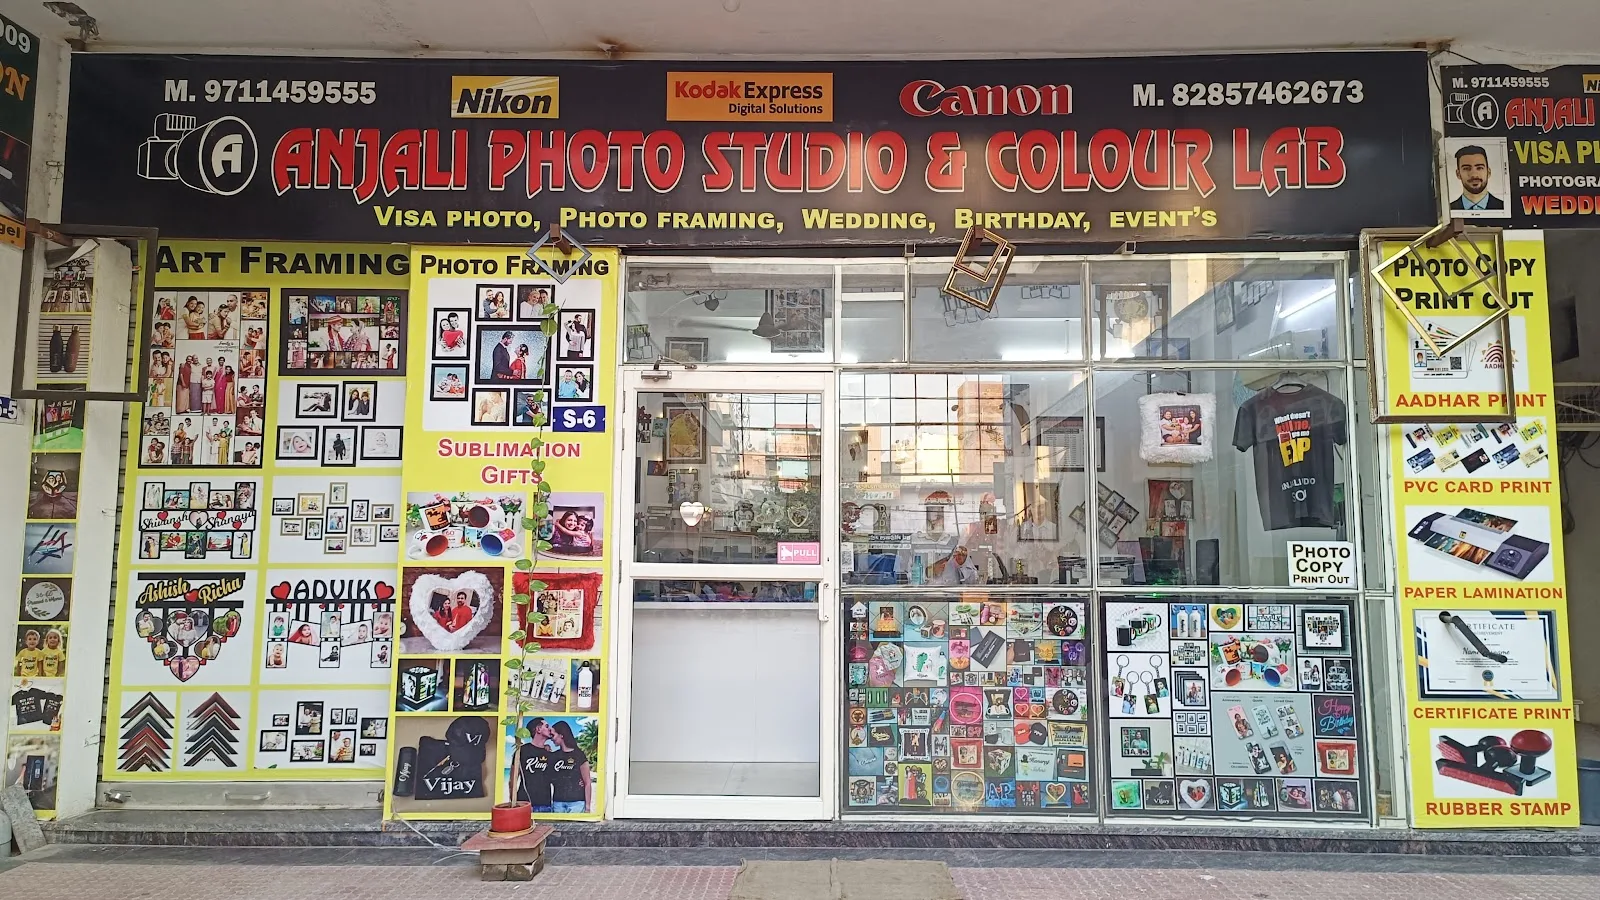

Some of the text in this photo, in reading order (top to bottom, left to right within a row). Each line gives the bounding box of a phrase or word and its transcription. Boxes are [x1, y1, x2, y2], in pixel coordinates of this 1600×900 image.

[0, 20, 31, 54] 09
[0, 64, 30, 101] N
[164, 78, 377, 105] M. 9711459555
[674, 80, 823, 103] Kodak Express
[1452, 76, 1550, 89] M. 9711459555
[456, 87, 553, 115] Nikon
[899, 79, 1073, 117] Canon
[1132, 80, 1364, 107] M. 82857462673
[728, 102, 823, 115] Digital Solutions
[1504, 97, 1596, 133] ANJALI
[211, 133, 243, 178] A
[1514, 140, 1572, 165] VISA
[271, 125, 1347, 205] ANJALI PHOTO STUDIO & COLOUR LAB
[154, 245, 410, 276] ART FRAMING
[420, 254, 609, 276] PHOTO FRAMING
[1393, 257, 1469, 278] PHOTO
[1394, 287, 1474, 310] PRINT
[1395, 393, 1481, 408] AADHAR
[563, 409, 596, 429] S-6
[1279, 437, 1311, 467] EXP
[480, 465, 543, 485] GIFTS
[1403, 480, 1553, 494] PVC CARD PRINT
[793, 548, 817, 557] PULL
[1292, 544, 1351, 559] PHOTO
[1295, 558, 1344, 573] COPY
[1292, 573, 1350, 584] PRINT OUT
[140, 577, 242, 605] Ashish Richa
[293, 579, 372, 600] ADVIK
[1404, 586, 1563, 600] PAPER LAMINATION
[1454, 623, 1516, 631] RTIFICATE
[1317, 698, 1351, 718] Happy
[1413, 707, 1572, 720] CERTIFICATE PRINT
[1319, 714, 1354, 733] Birthday
[525, 756, 548, 774] King
[424, 777, 476, 795] Vijay
[1425, 802, 1572, 816] RUBBER STAMP
